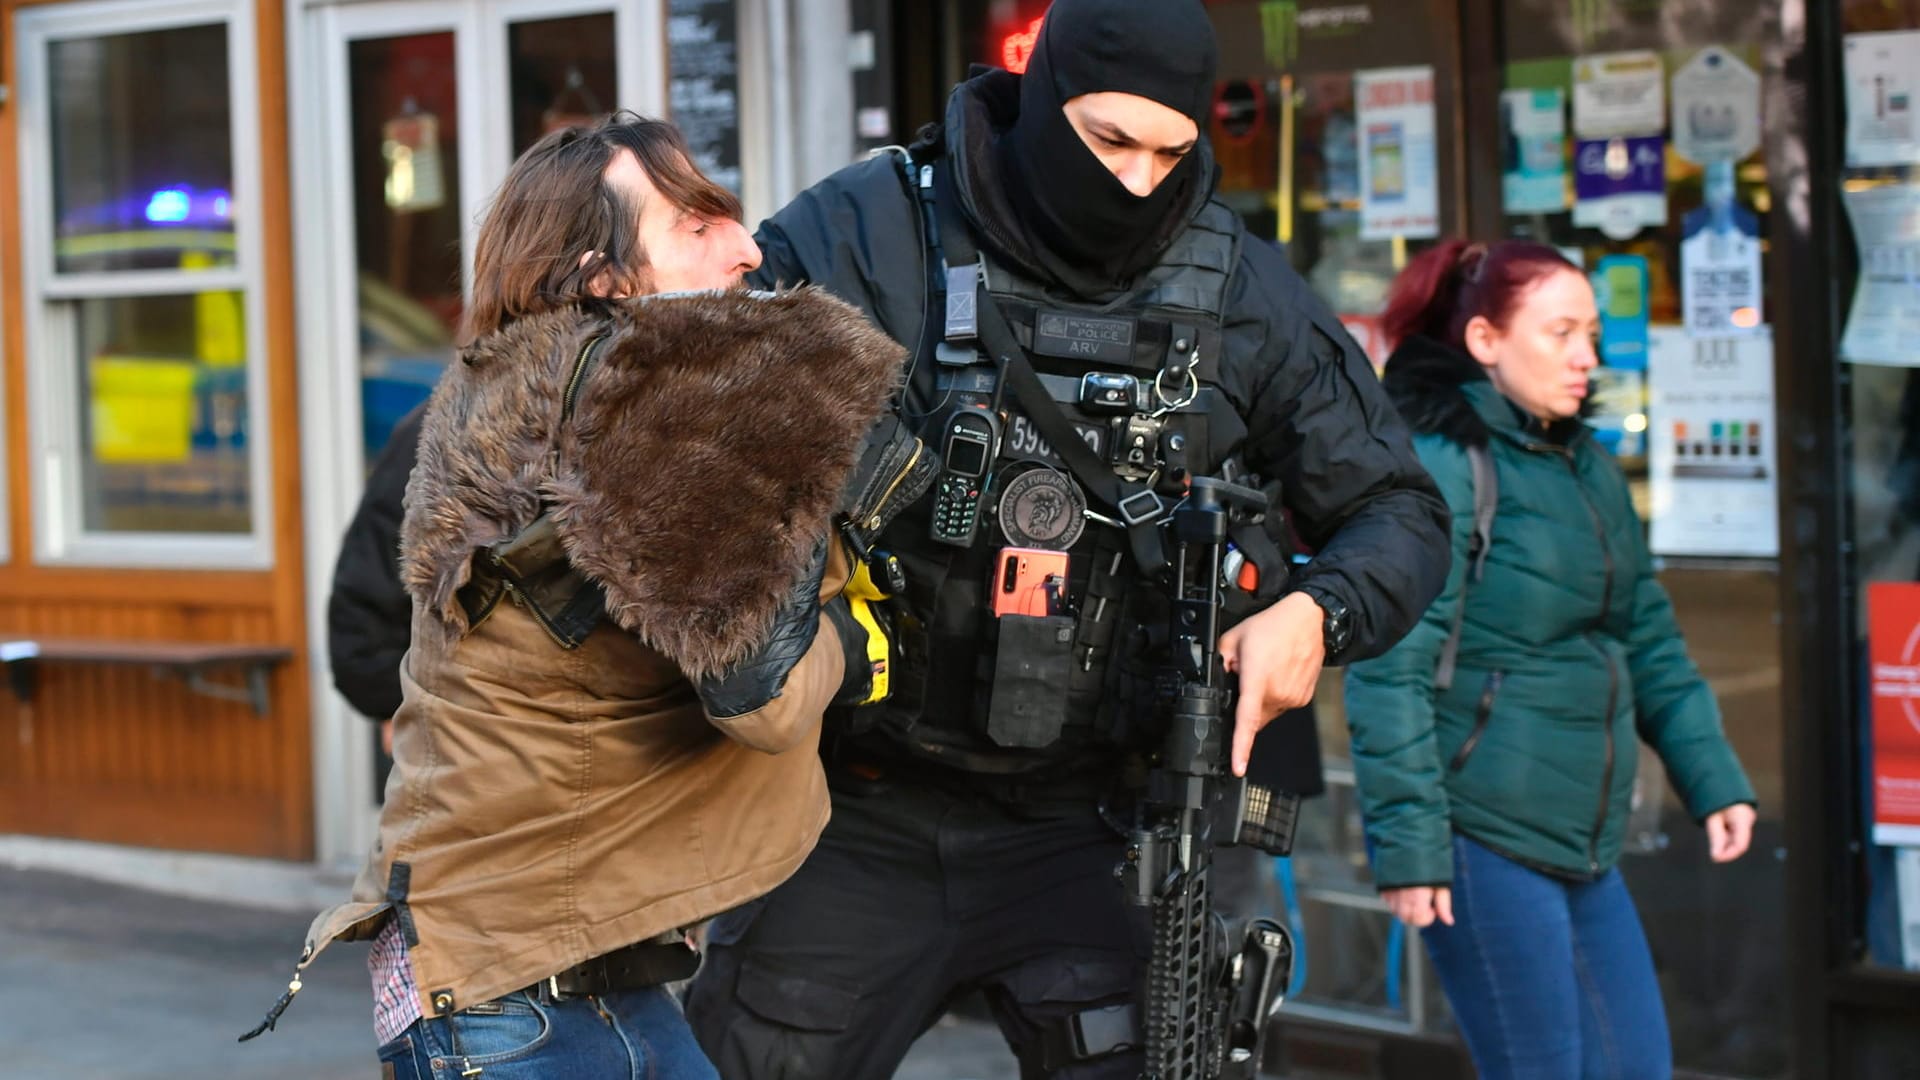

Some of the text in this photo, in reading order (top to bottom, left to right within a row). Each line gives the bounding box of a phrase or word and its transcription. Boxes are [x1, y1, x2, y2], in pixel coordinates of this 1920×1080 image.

[1077, 328, 1119, 341] POLICE
[1069, 341, 1100, 354] ARV
[1003, 480, 1027, 534] SPECIALIST
